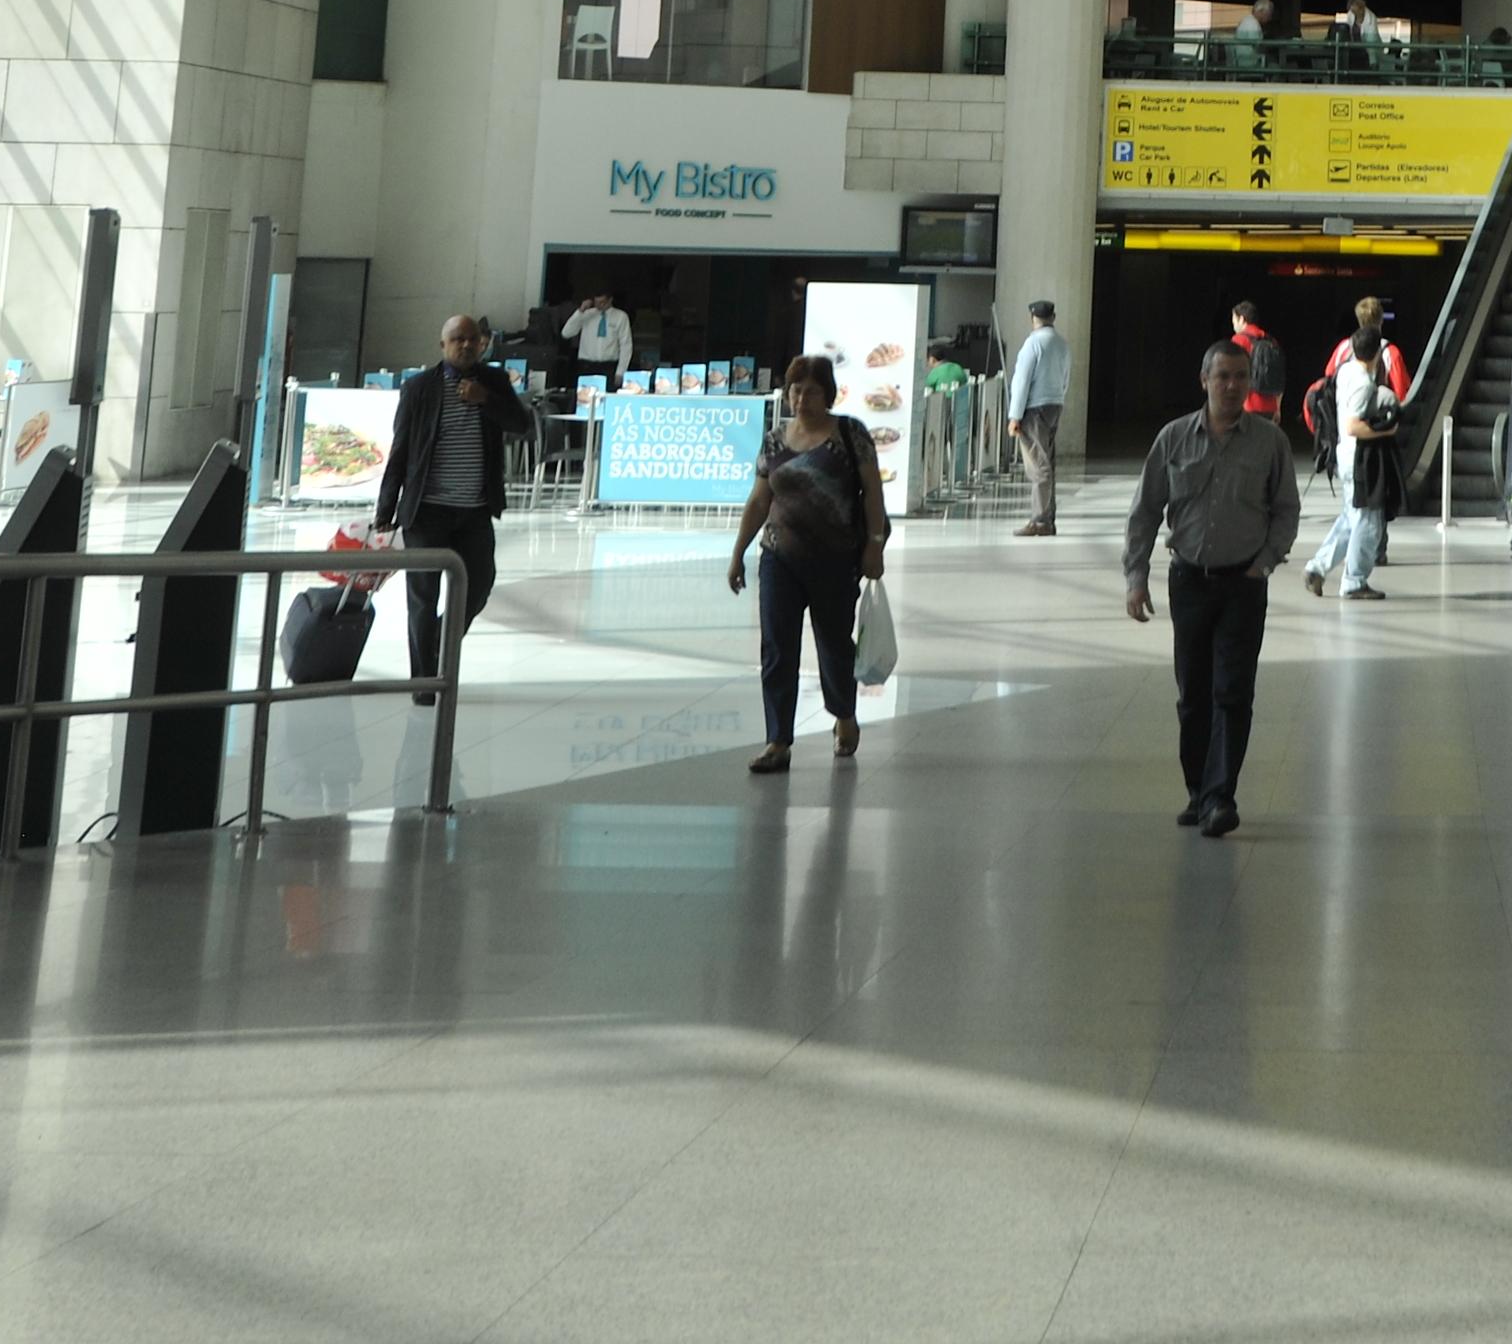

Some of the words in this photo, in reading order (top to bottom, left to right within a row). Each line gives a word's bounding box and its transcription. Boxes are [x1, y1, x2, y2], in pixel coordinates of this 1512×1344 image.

[1177, 96, 1187, 104] de
[1358, 101, 1395, 110] Correios
[1358, 112, 1377, 120] Post
[1379, 112, 1404, 120] Office
[1194, 125, 1226, 133] Shuttles
[1140, 144, 1166, 152] Parque
[1358, 142, 1385, 151] Lounge
[1139, 153, 1152, 161] Car
[1154, 153, 1171, 161] Park
[1356, 163, 1390, 172] Partidas
[1397, 164, 1449, 173] (Elevadores)
[1112, 170, 1133, 181] WC
[1356, 174, 1401, 183] Departures
[1404, 174, 1428, 184] (Lifts)
[610, 160, 665, 204] My
[675, 161, 776, 201] Bistro
[654, 208, 682, 217] FOOD
[684, 209, 727, 218] CONCEPT
[612, 403, 633, 426] JÁ
[639, 407, 750, 426] DEGUSTOU
[611, 425, 638, 442] AS
[644, 426, 725, 443] NOSSAS
[610, 443, 734, 462] SABOROSAS
[609, 459, 753, 481] SANDUÍCHES?
